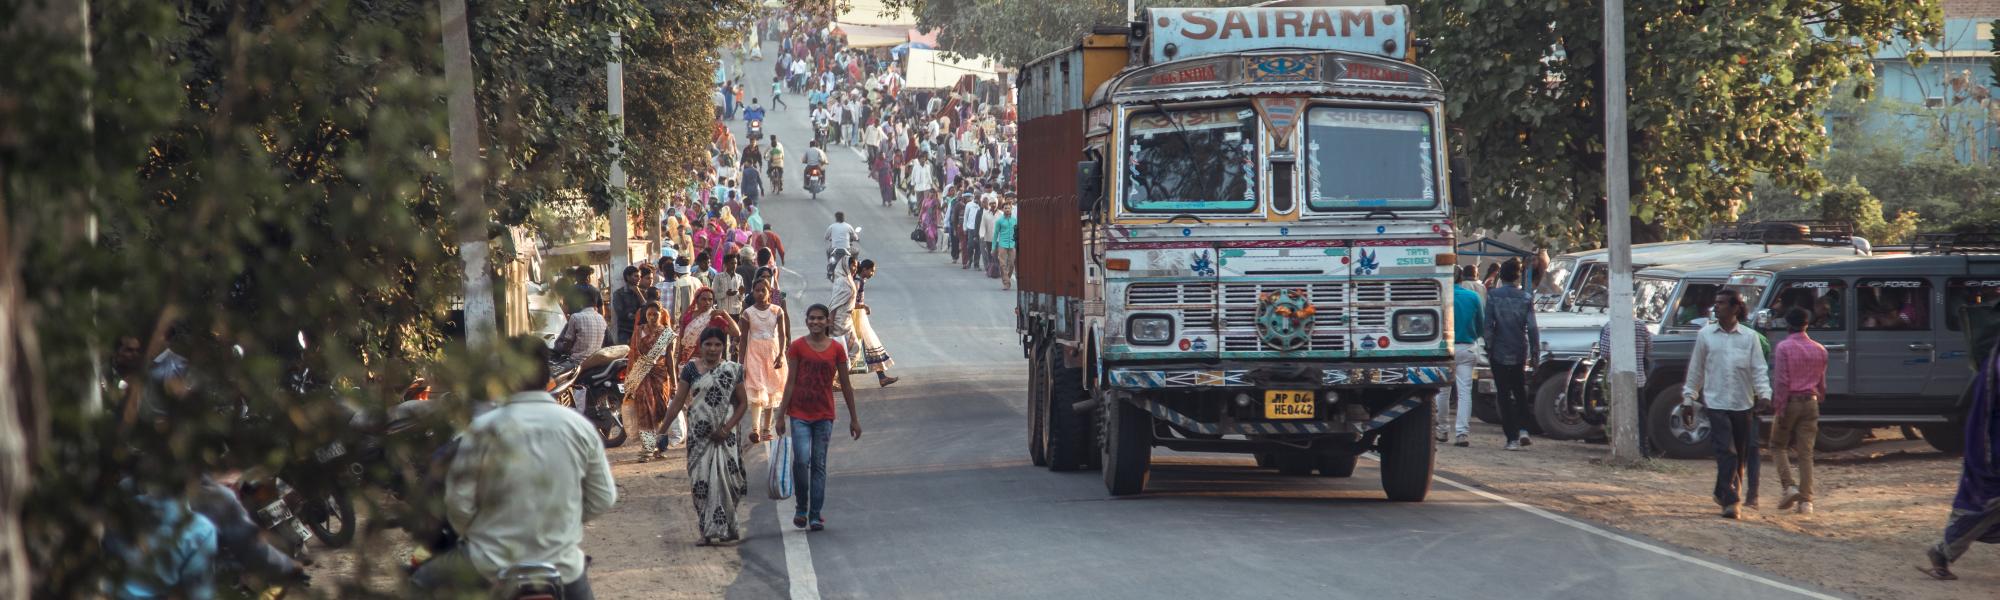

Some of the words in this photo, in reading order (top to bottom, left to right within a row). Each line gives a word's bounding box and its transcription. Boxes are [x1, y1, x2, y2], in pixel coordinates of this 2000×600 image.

[1180, 9, 1375, 40] SAIRAM
[1179, 64, 1217, 82] INDIA
[1405, 248, 1430, 256] TATA
[1802, 281, 1829, 289] FORCE
[1273, 393, 1289, 404] MP
[1274, 404, 1313, 415] HE0442
